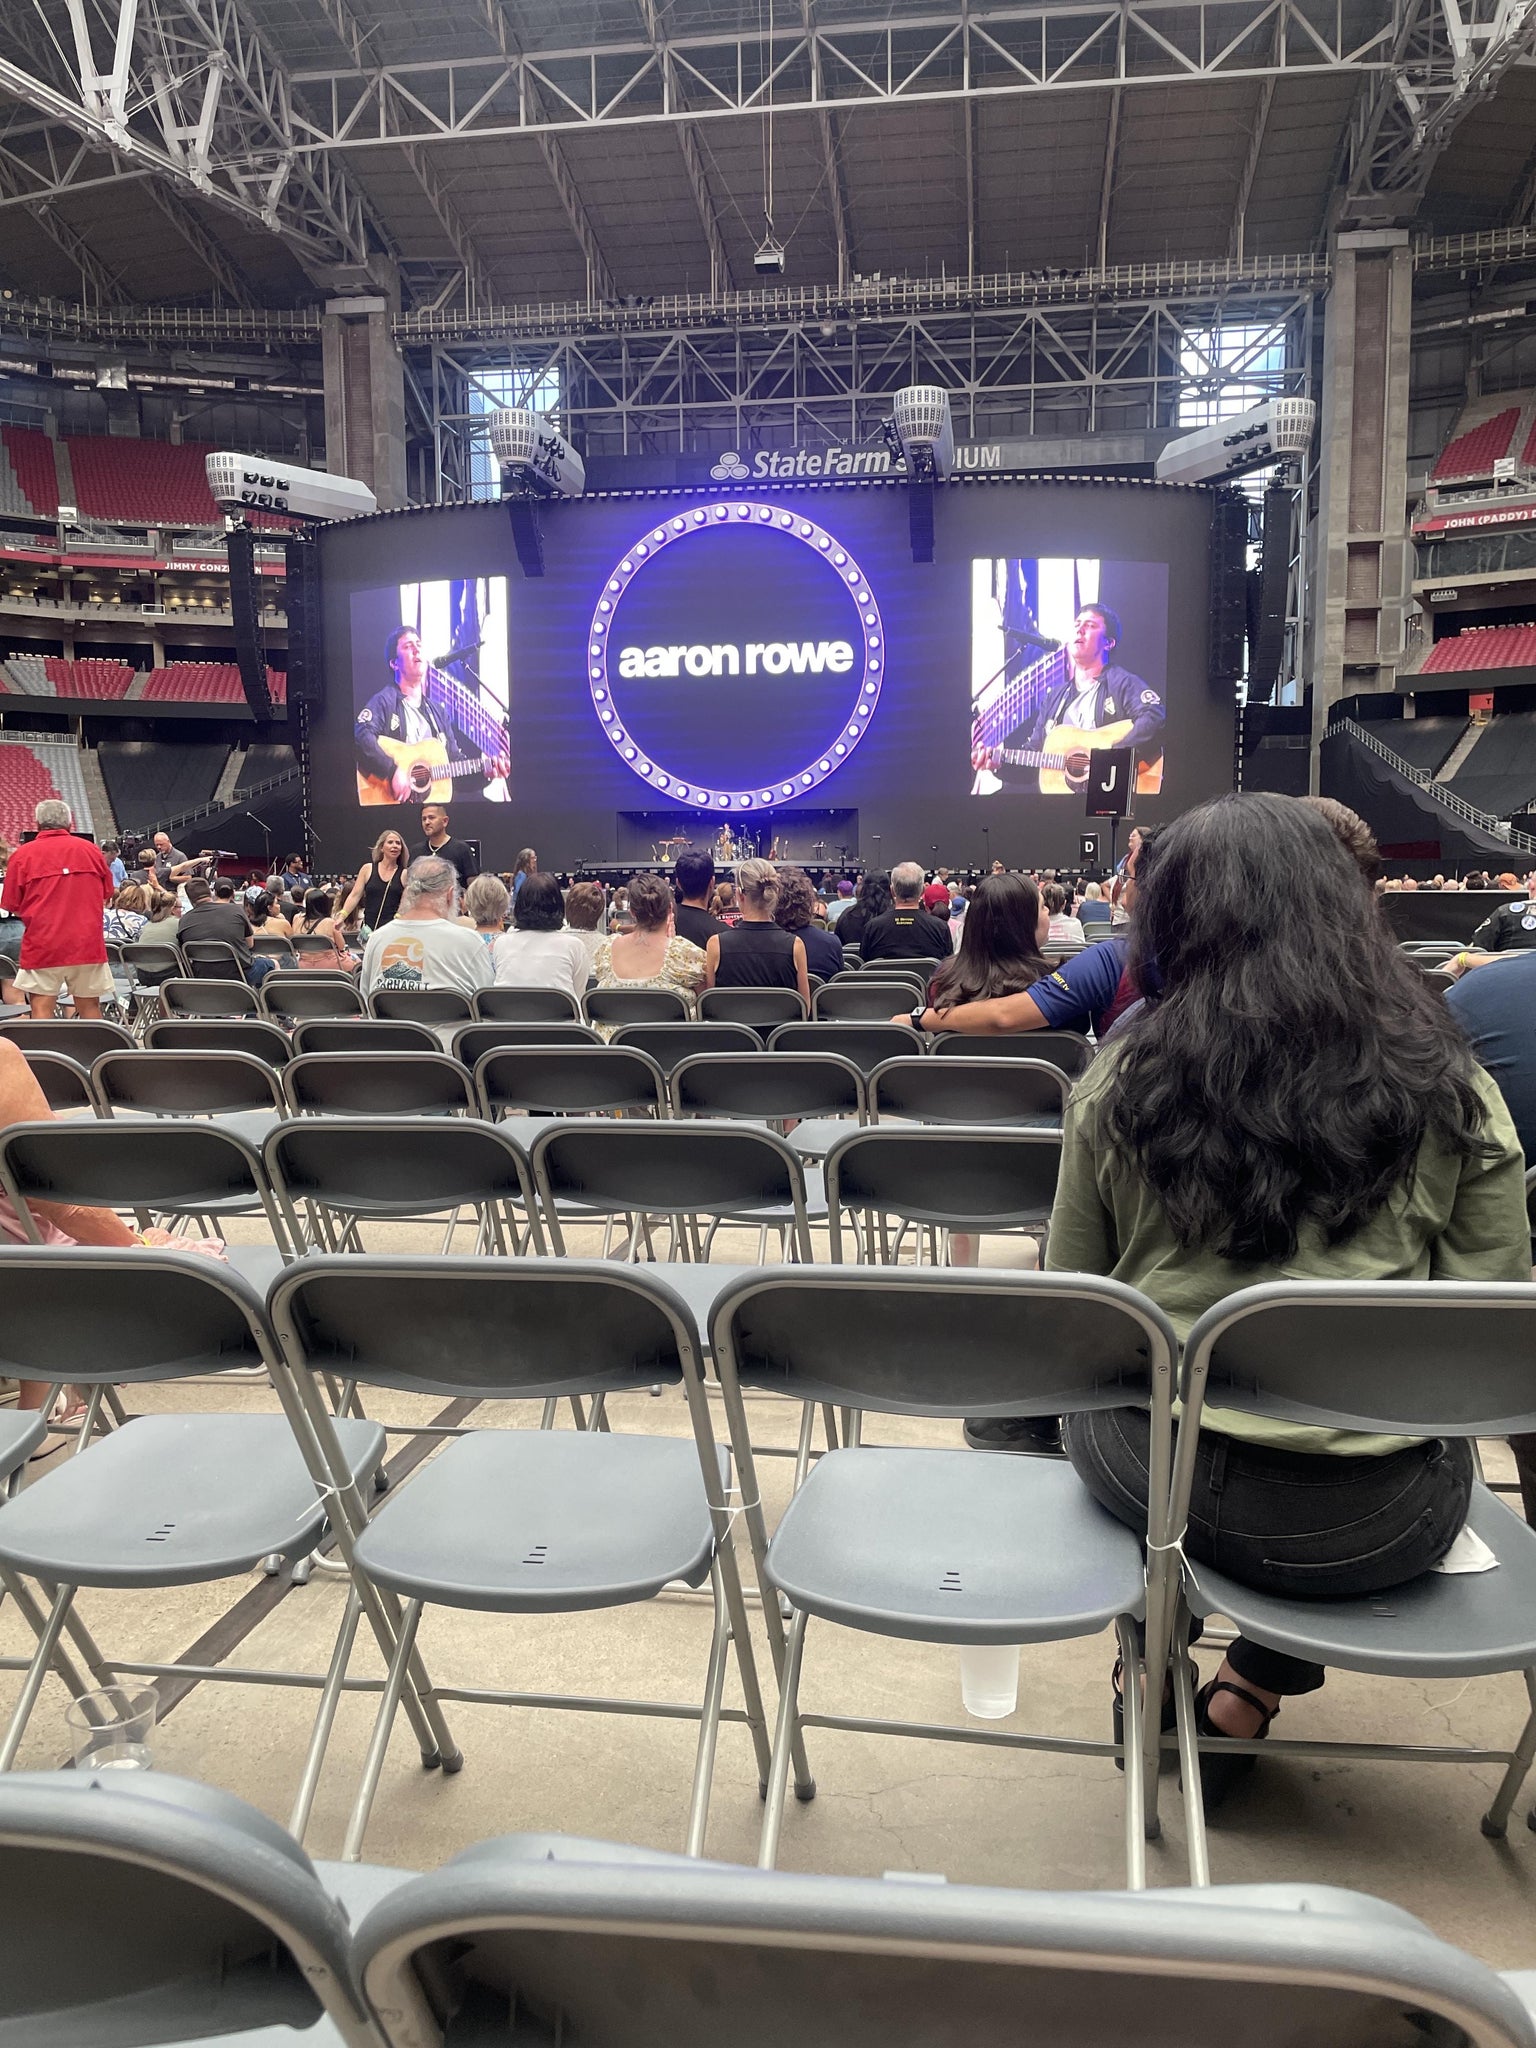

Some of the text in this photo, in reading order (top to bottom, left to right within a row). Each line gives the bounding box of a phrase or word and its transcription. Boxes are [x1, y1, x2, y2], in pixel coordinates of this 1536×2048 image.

[1443, 518, 1475, 529] JOHN
[1478, 510, 1529, 526] (PADDY)
[164, 562, 198, 571] JIMMY
[618, 640, 854, 678] aaron rowe
[1101, 765, 1117, 792] J
[1085, 841, 1094, 852] D
